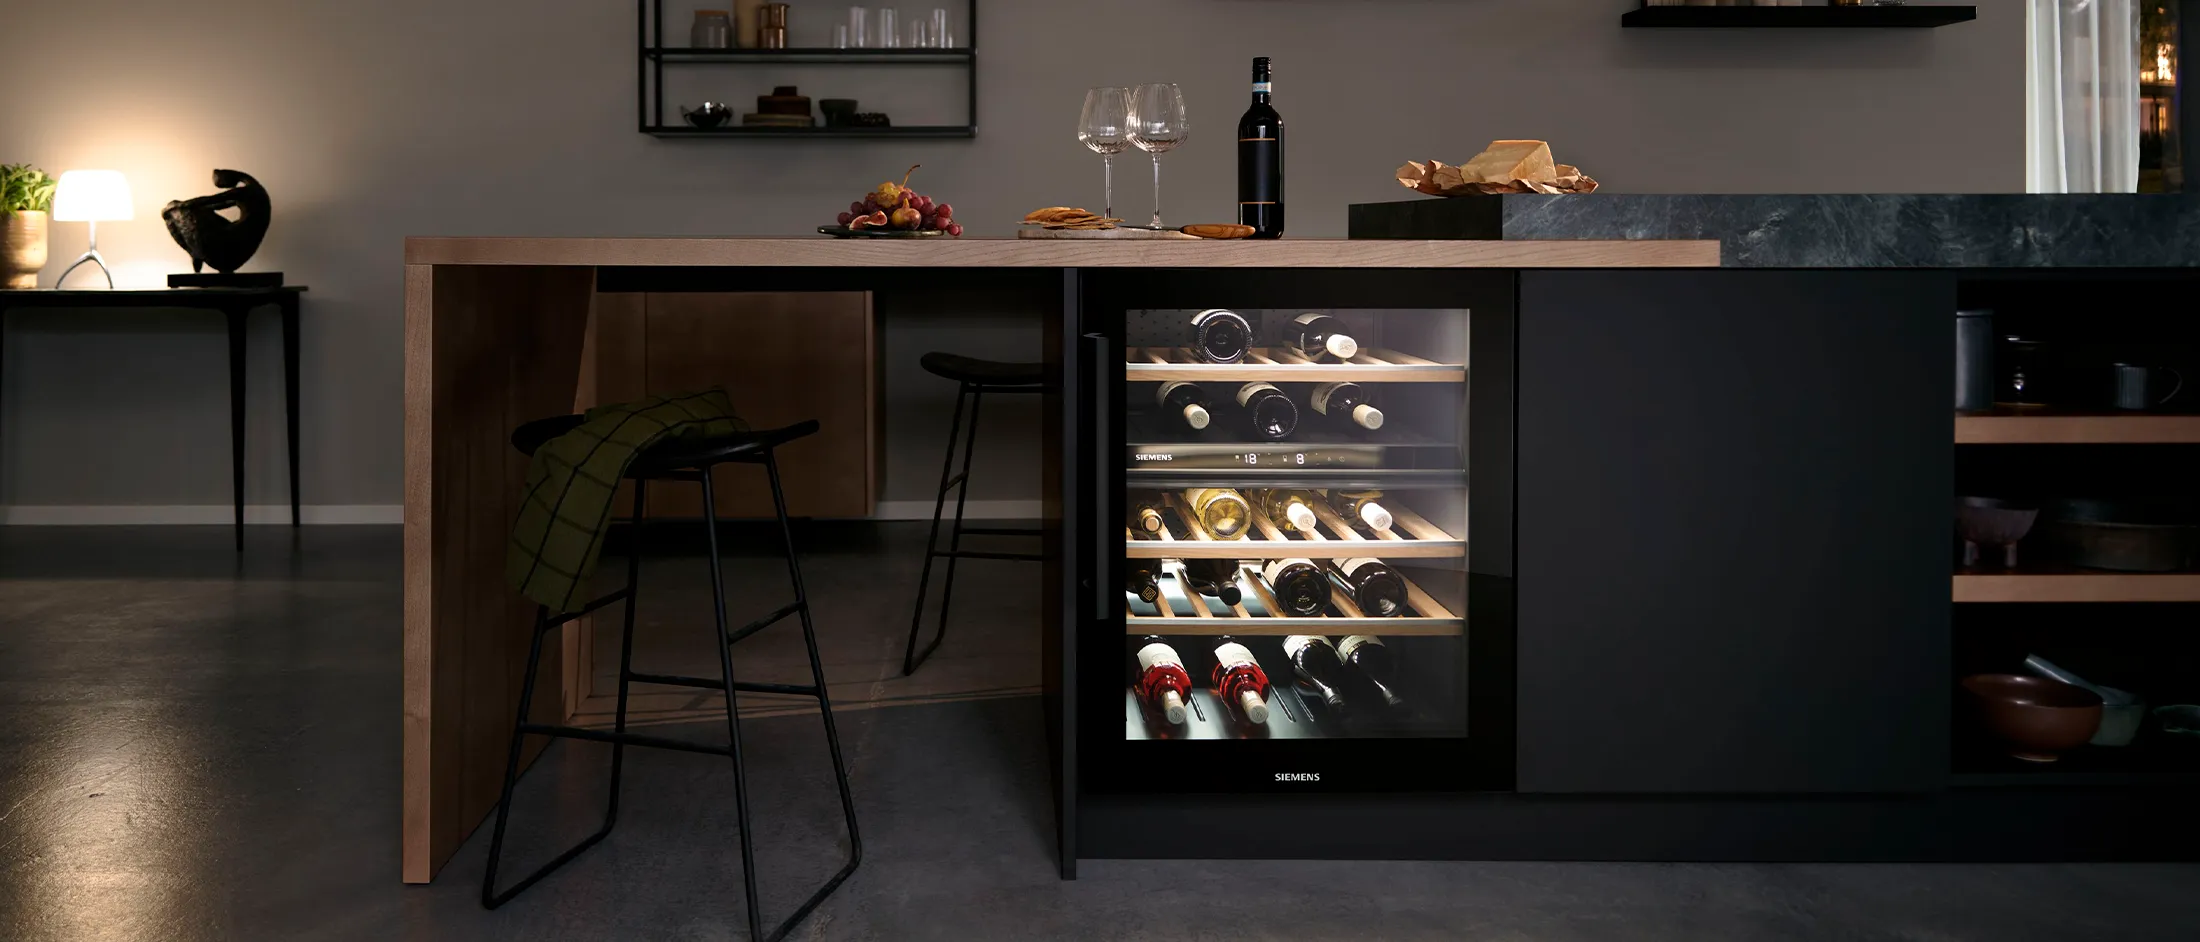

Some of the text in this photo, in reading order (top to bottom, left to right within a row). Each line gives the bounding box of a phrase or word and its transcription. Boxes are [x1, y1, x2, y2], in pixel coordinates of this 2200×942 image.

[1244, 453, 1257, 464] 18
[1296, 453, 1305, 465] 8
[1274, 773, 1321, 782] SIEMENS
